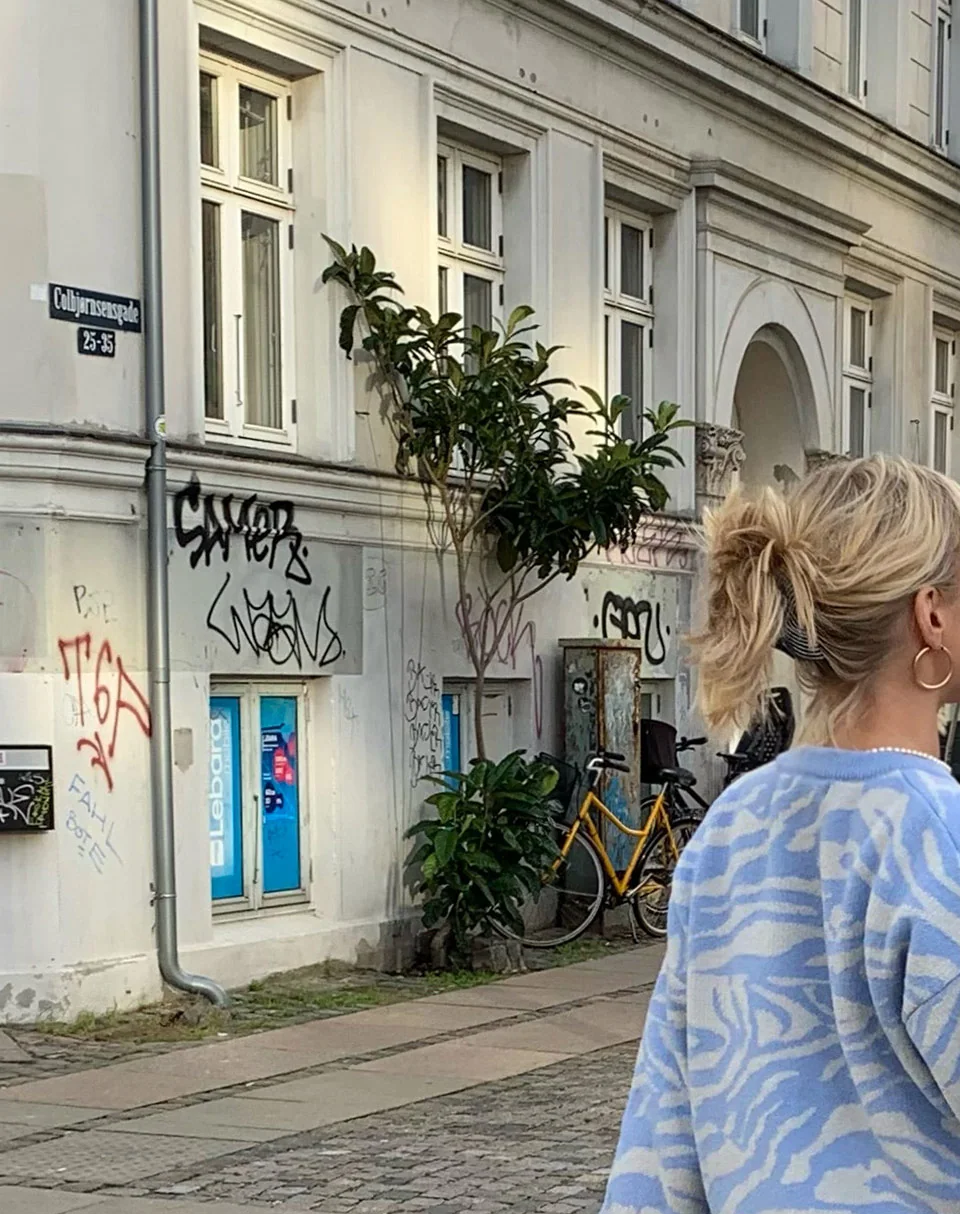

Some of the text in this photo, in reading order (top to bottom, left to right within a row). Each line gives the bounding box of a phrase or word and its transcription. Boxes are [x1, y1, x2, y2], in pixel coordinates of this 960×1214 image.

[53, 287, 139, 326] Colbjørnsensgade
[83, 330, 114, 354] 25-35
[209, 718, 225, 837] Lebara
